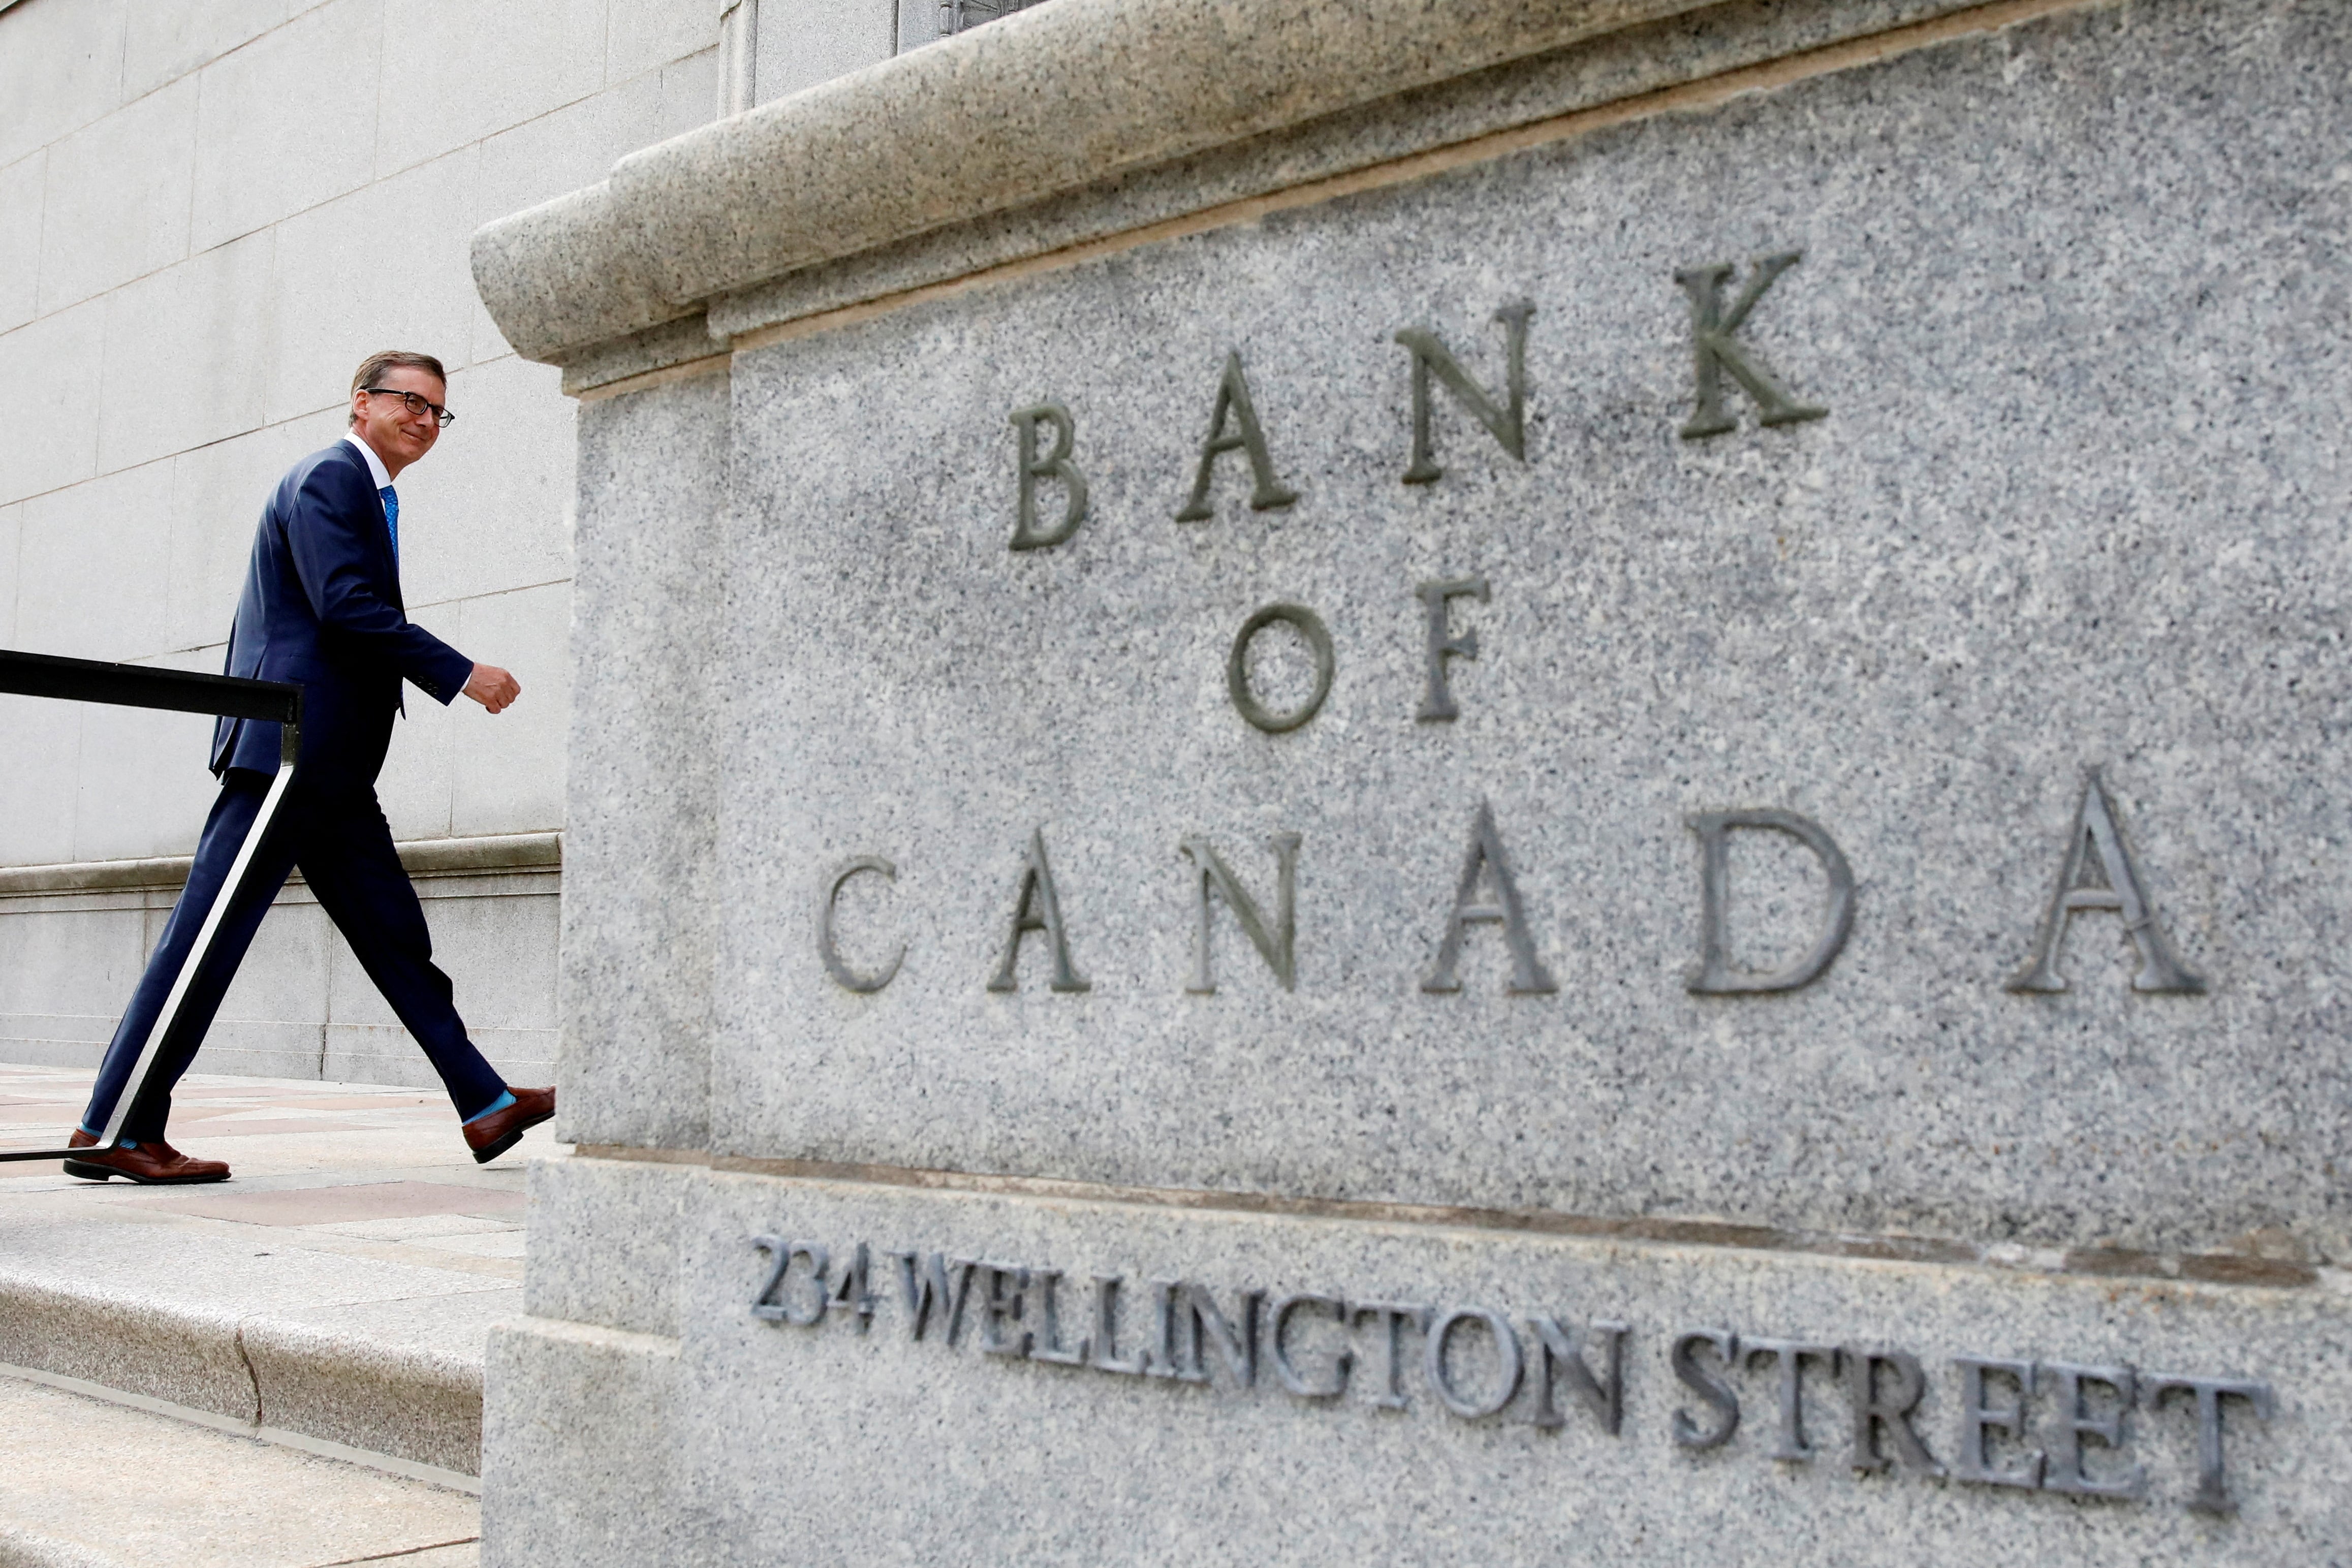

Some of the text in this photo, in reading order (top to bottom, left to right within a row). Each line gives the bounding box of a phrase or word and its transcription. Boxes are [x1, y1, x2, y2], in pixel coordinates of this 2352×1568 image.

[1008, 250, 1830, 552] BANK
[1227, 574, 1491, 733] OF
[819, 768, 2207, 996] CANADA
[749, 1233, 2277, 1516] 234 WELLINGTON STREET
